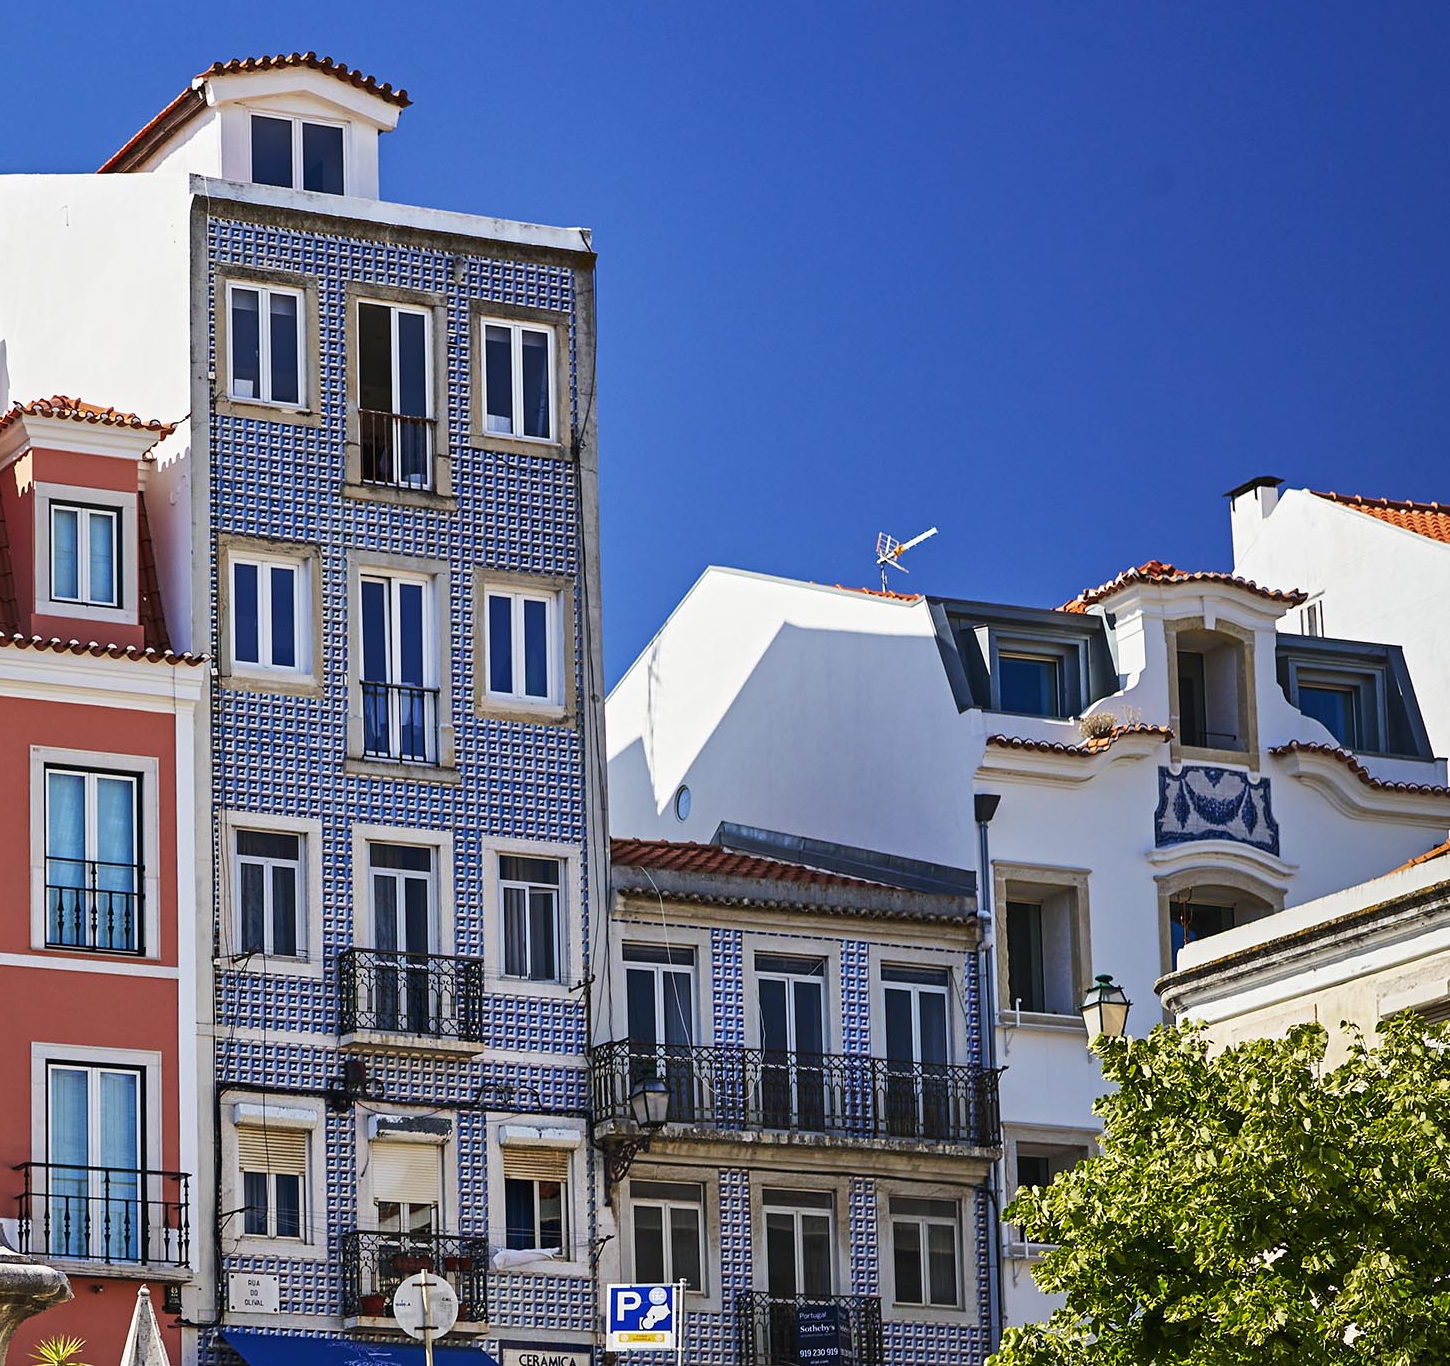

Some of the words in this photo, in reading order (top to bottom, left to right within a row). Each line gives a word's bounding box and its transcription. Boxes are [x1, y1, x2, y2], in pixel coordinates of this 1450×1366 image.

[244, 1298, 264, 1306] OLIVAL
[617, 1291, 642, 1321] P
[799, 1311, 827, 1320] Portugal
[799, 1324, 836, 1333] Sotheby's
[799, 1349, 812, 1358] 919
[812, 1348, 826, 1357] 230
[826, 1347, 839, 1356] 919
